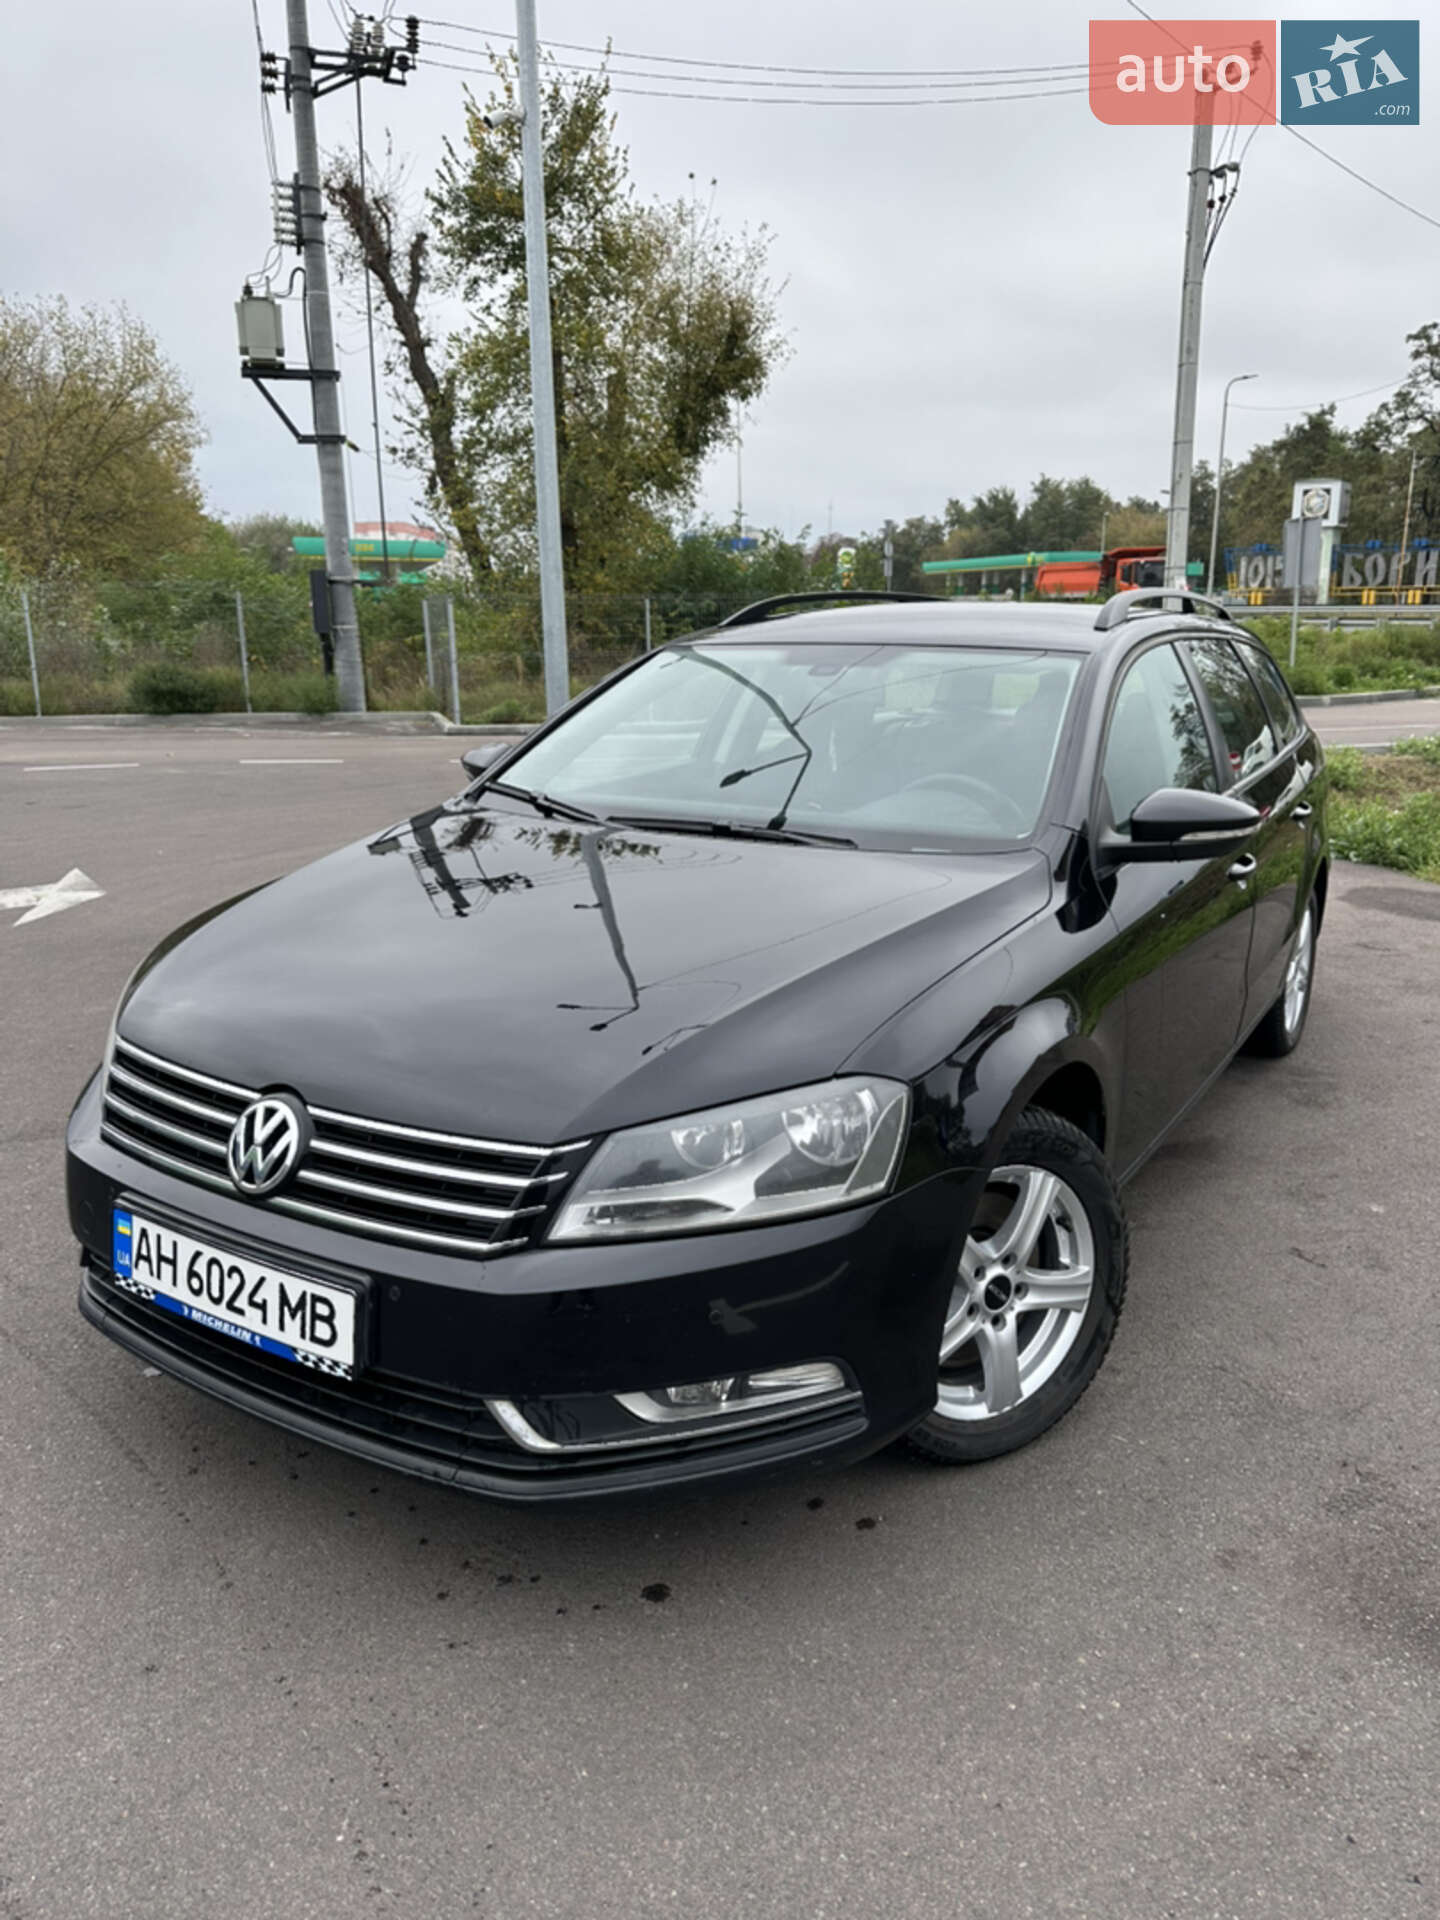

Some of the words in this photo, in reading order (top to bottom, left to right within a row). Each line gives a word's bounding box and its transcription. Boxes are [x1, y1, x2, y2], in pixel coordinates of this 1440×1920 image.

[117, 1251, 131, 1267] UA
[134, 1227, 178, 1287] AH
[186, 1250, 268, 1325] 6024
[278, 1282, 338, 1348] MB
[191, 1308, 252, 1344] MICHELIN
